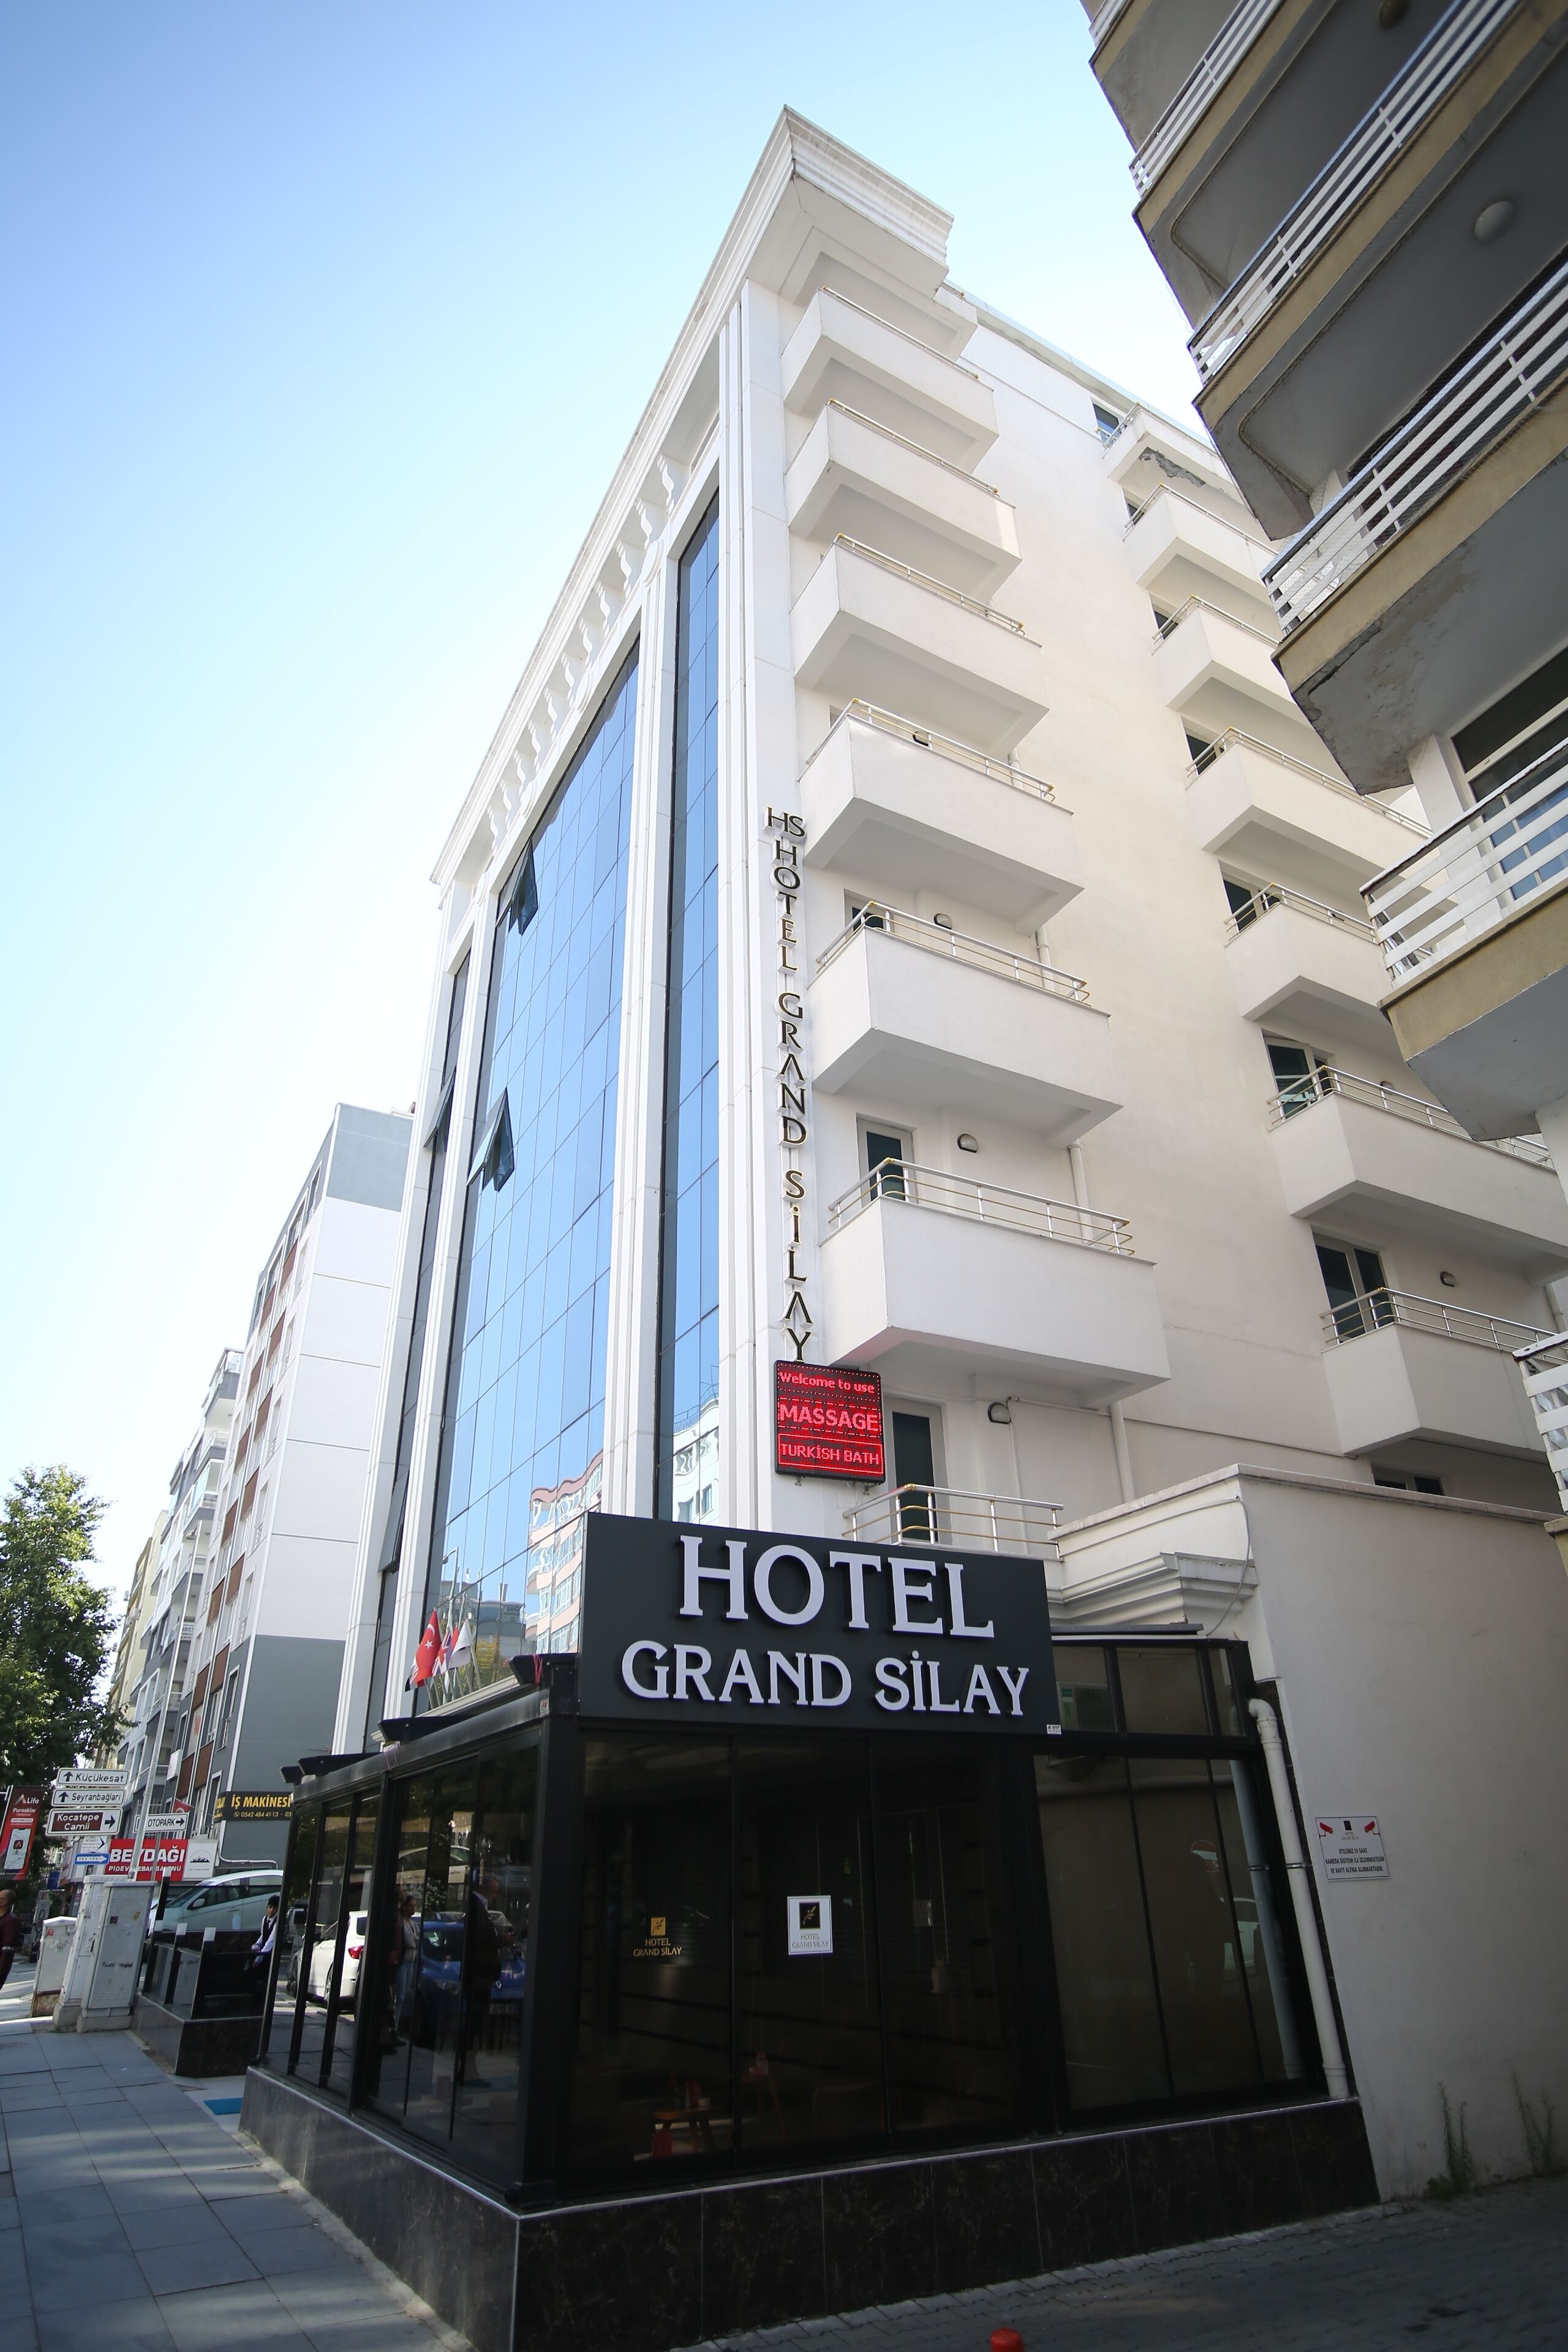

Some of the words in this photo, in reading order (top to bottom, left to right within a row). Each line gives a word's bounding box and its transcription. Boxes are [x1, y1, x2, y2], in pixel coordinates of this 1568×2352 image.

[766, 807, 805, 837] HS
[773, 839, 801, 972] HOTEL
[777, 992, 807, 1145] GRAND
[783, 1170, 813, 1361] SİLAY
[779, 1371, 835, 1389] Welcome
[838, 1379, 851, 1390] to
[853, 1383, 875, 1393] use
[779, 1404, 878, 1431] MASSAGE
[843, 1449, 880, 1465] BATH
[680, 1535, 995, 1638] HOTEL
[622, 1640, 852, 1707] GRAND
[875, 1650, 1029, 1716] SİLAY
[75, 1773, 124, 1782] Küçükesat
[72, 1792, 121, 1803] Seyranbağları
[231, 1794, 241, 1809] İŞ
[243, 1795, 291, 1807] MAKİNESİ
[57, 1814, 99, 1822] Kocatepe
[148, 1818, 176, 1827] OTOPARK
[633, 1948, 660, 1957] GRAND
[661, 1947, 682, 1956] SİLAY
[645, 1938, 671, 1947] HOTEL
